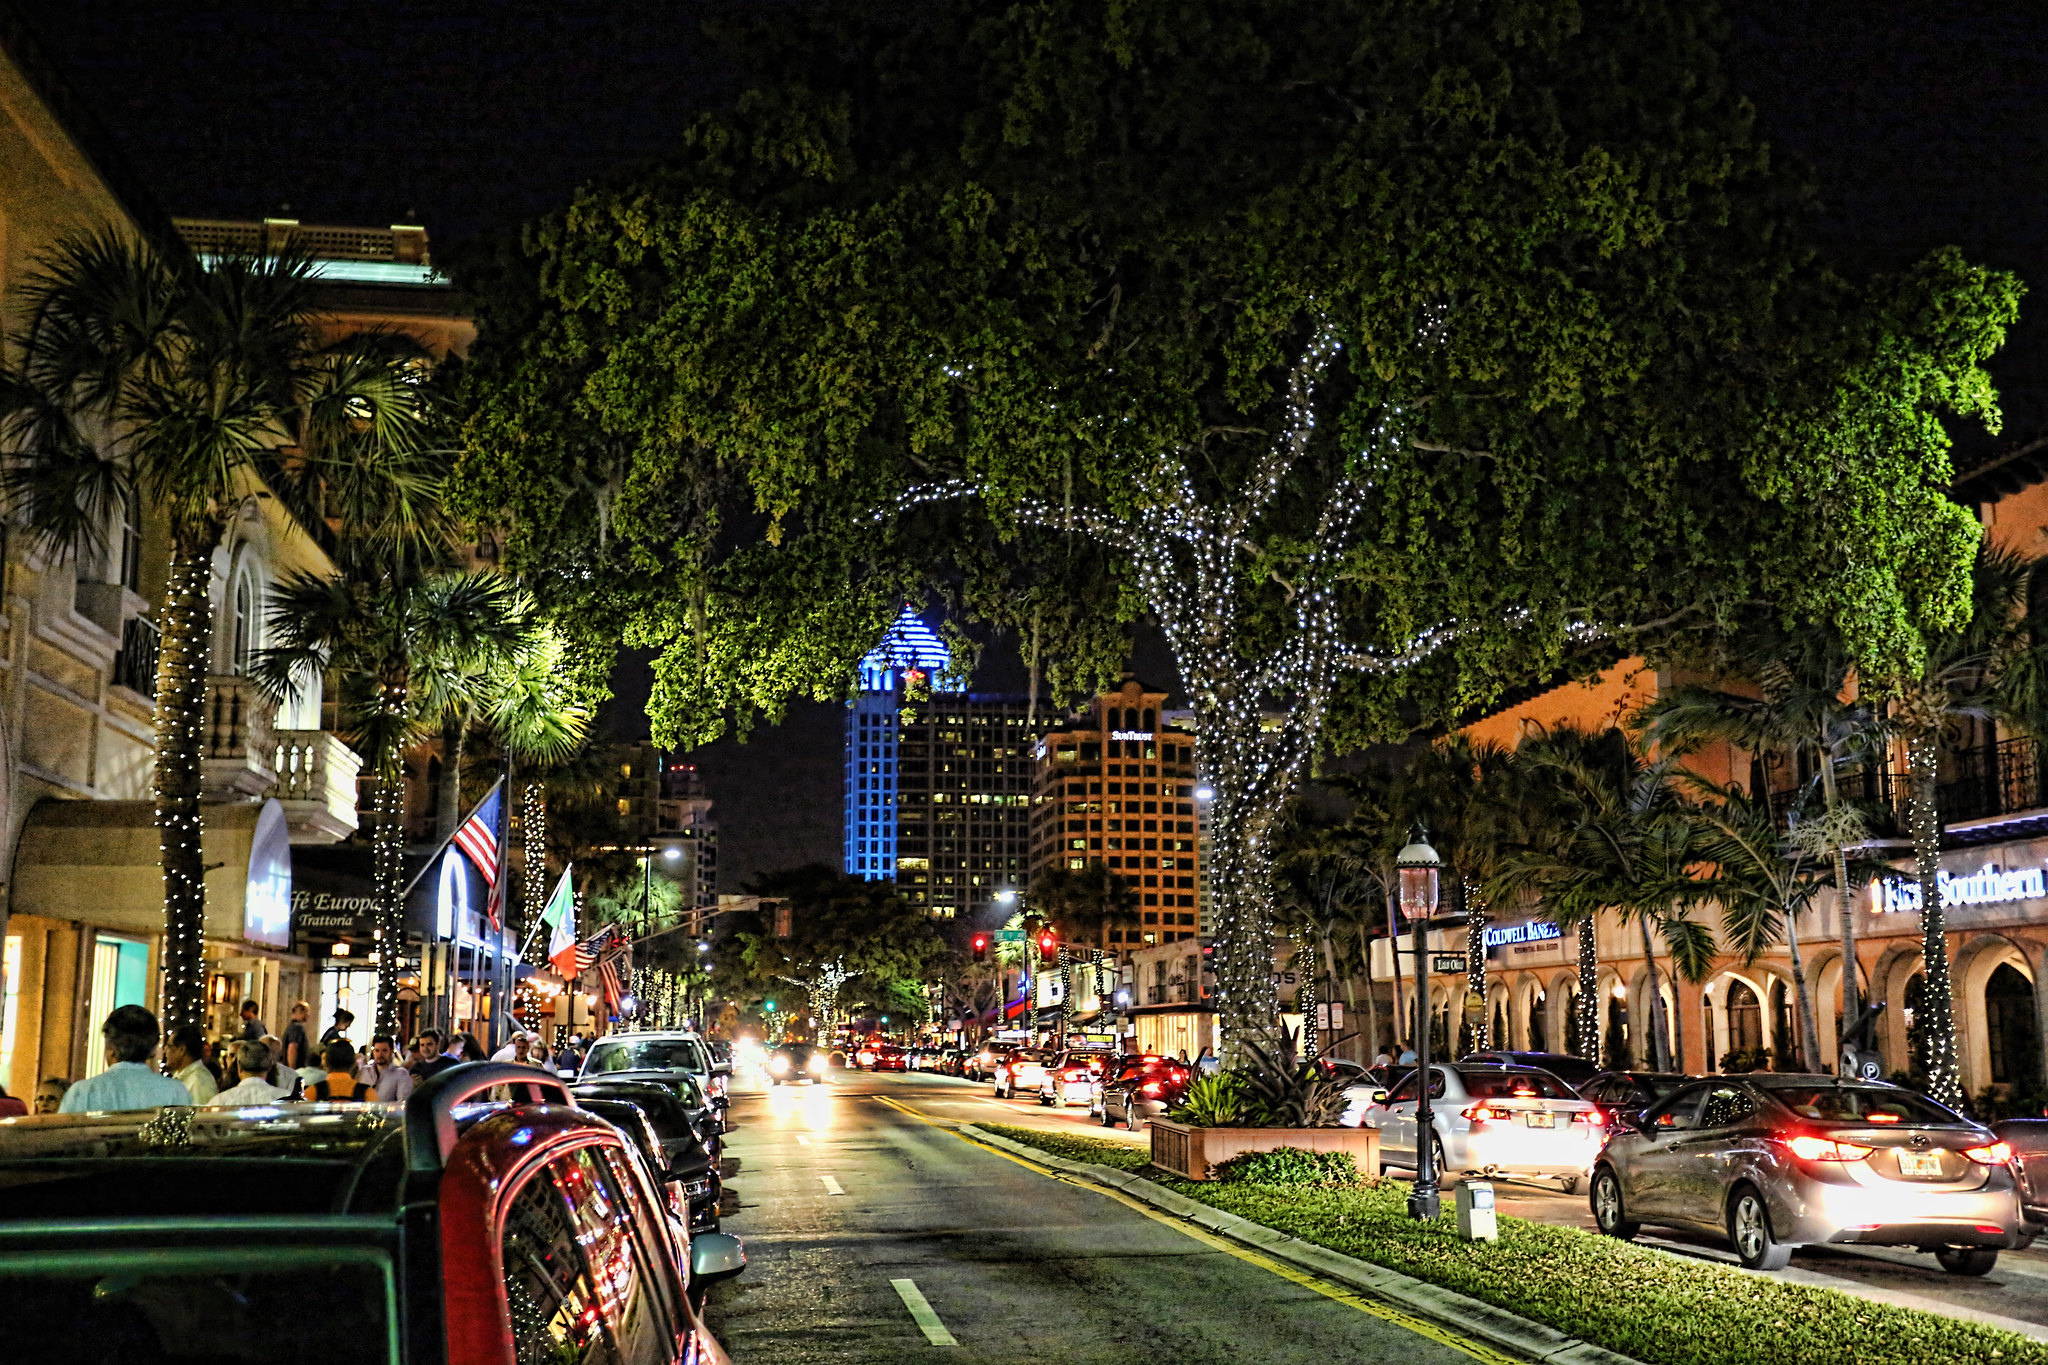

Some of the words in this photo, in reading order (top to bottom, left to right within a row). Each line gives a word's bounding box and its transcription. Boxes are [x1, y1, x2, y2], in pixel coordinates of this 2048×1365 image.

[1936, 862, 2046, 910] Southern
[299, 914, 353, 927] Trattoria
[1486, 926, 1527, 947] COLDWELL
